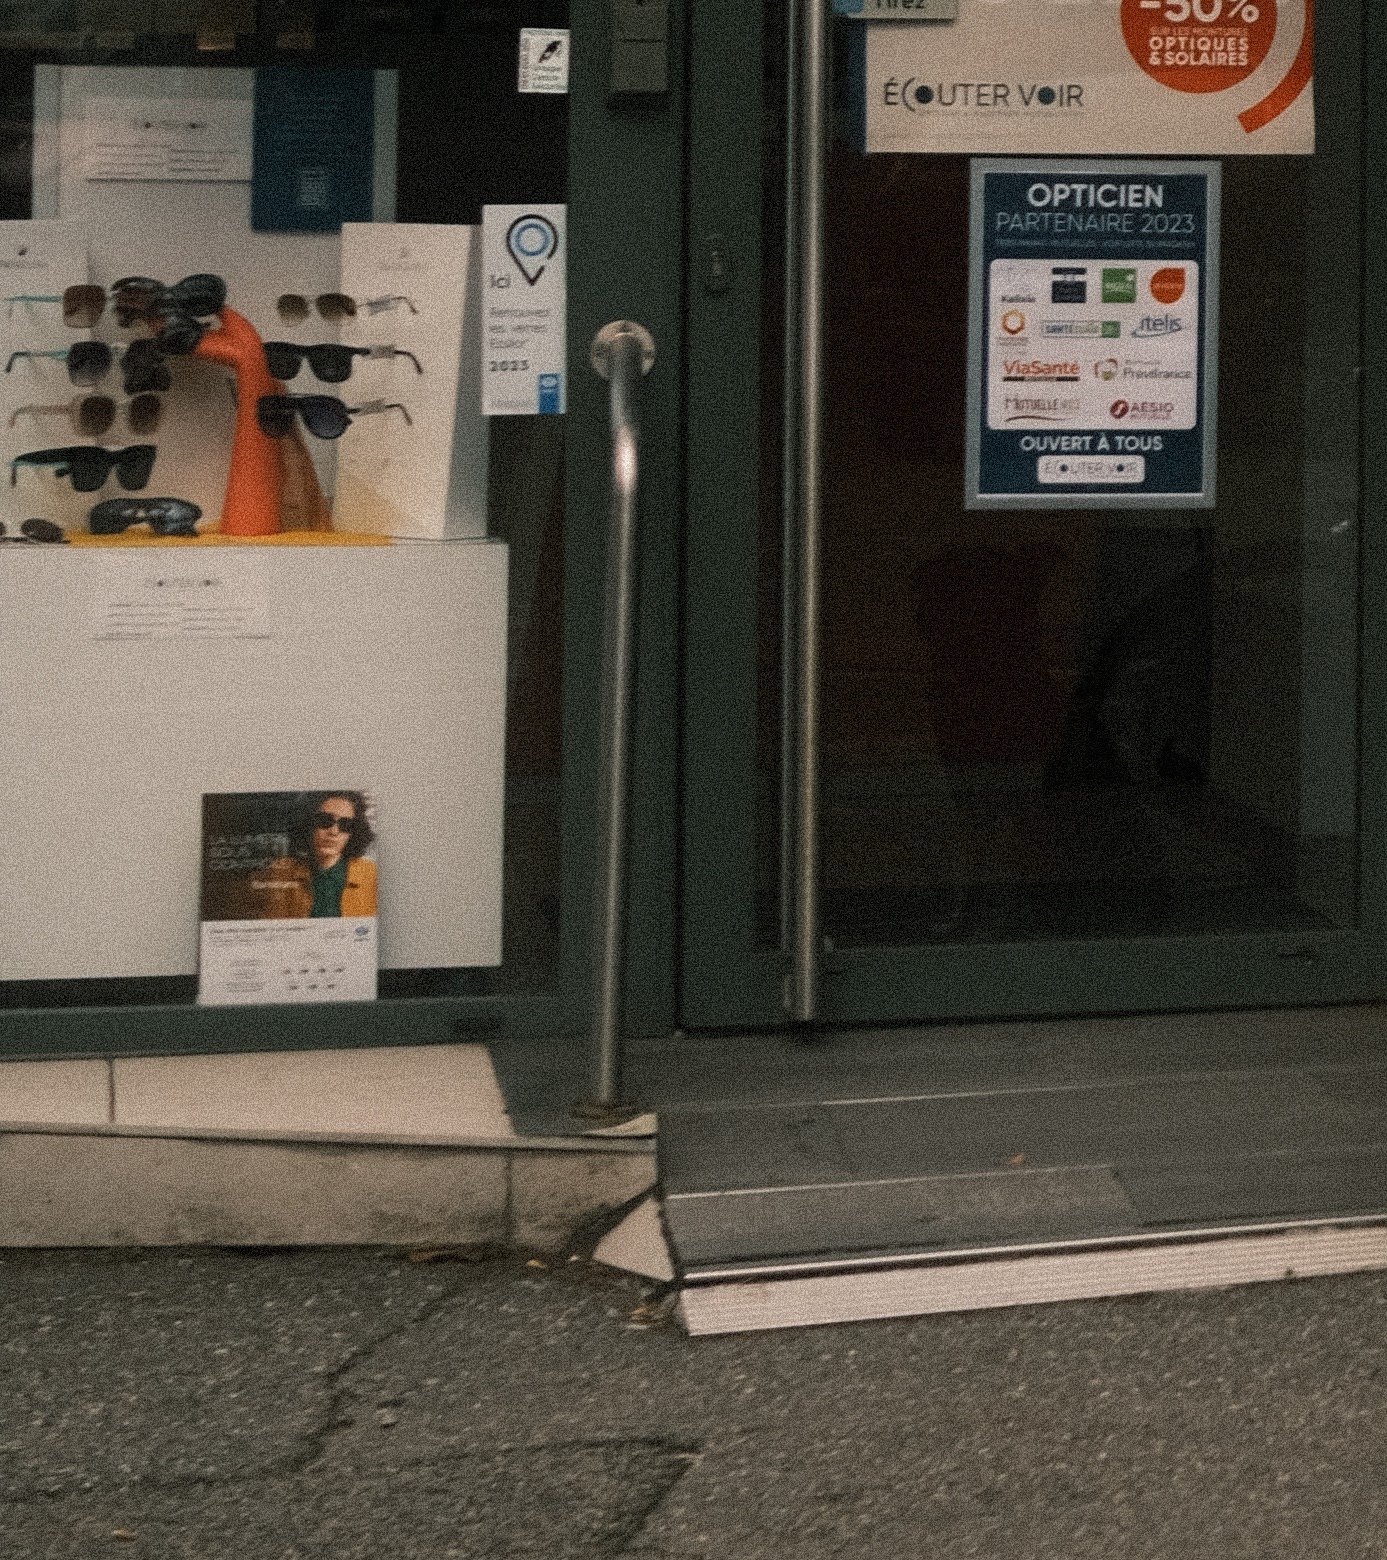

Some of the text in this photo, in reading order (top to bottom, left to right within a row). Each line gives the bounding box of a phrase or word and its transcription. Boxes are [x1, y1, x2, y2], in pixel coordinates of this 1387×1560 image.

[1148, 36, 1249, 52] OPTIQUES
[1148, 51, 1248, 67] & SOLAIRES
[1018, 84, 1084, 107] VOIR
[1027, 183, 1164, 208] OPTICIEN
[996, 211, 1196, 234] PARTENAIRE 2023
[1003, 359, 1080, 375] ViaSanté
[1020, 432, 1164, 452] OUVERT À TOUS
